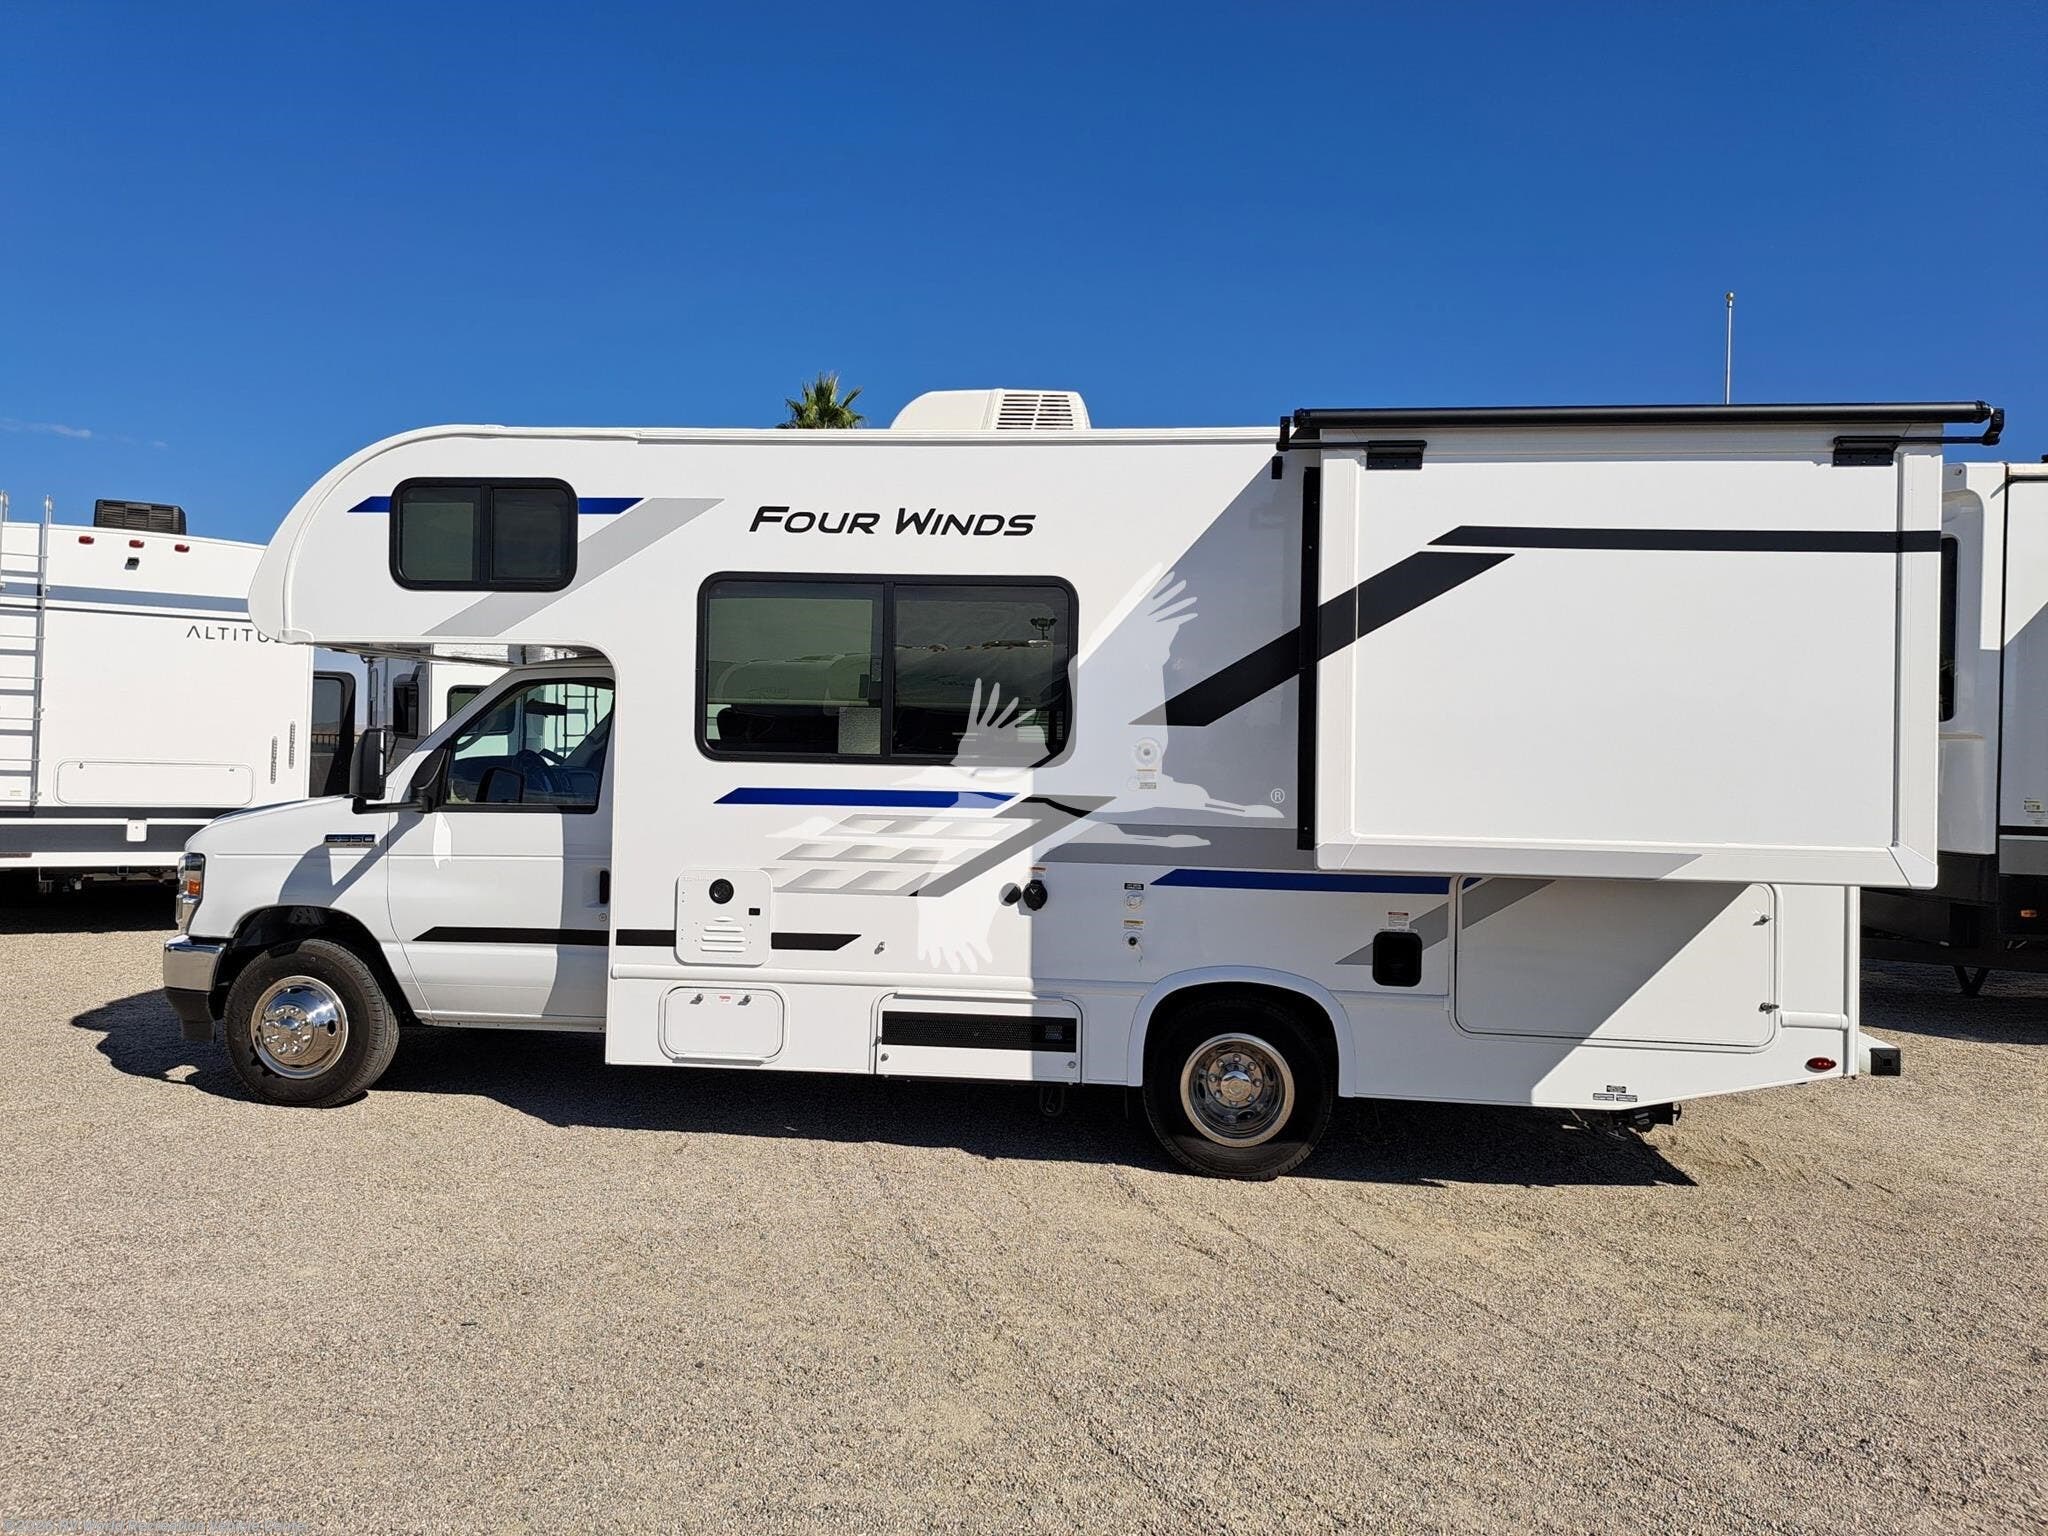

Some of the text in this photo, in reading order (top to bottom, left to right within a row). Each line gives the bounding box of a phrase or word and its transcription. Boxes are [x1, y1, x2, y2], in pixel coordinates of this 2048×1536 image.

[749, 506, 1037, 536] FOUR WINDS
[186, 625, 281, 643] ALTITU
